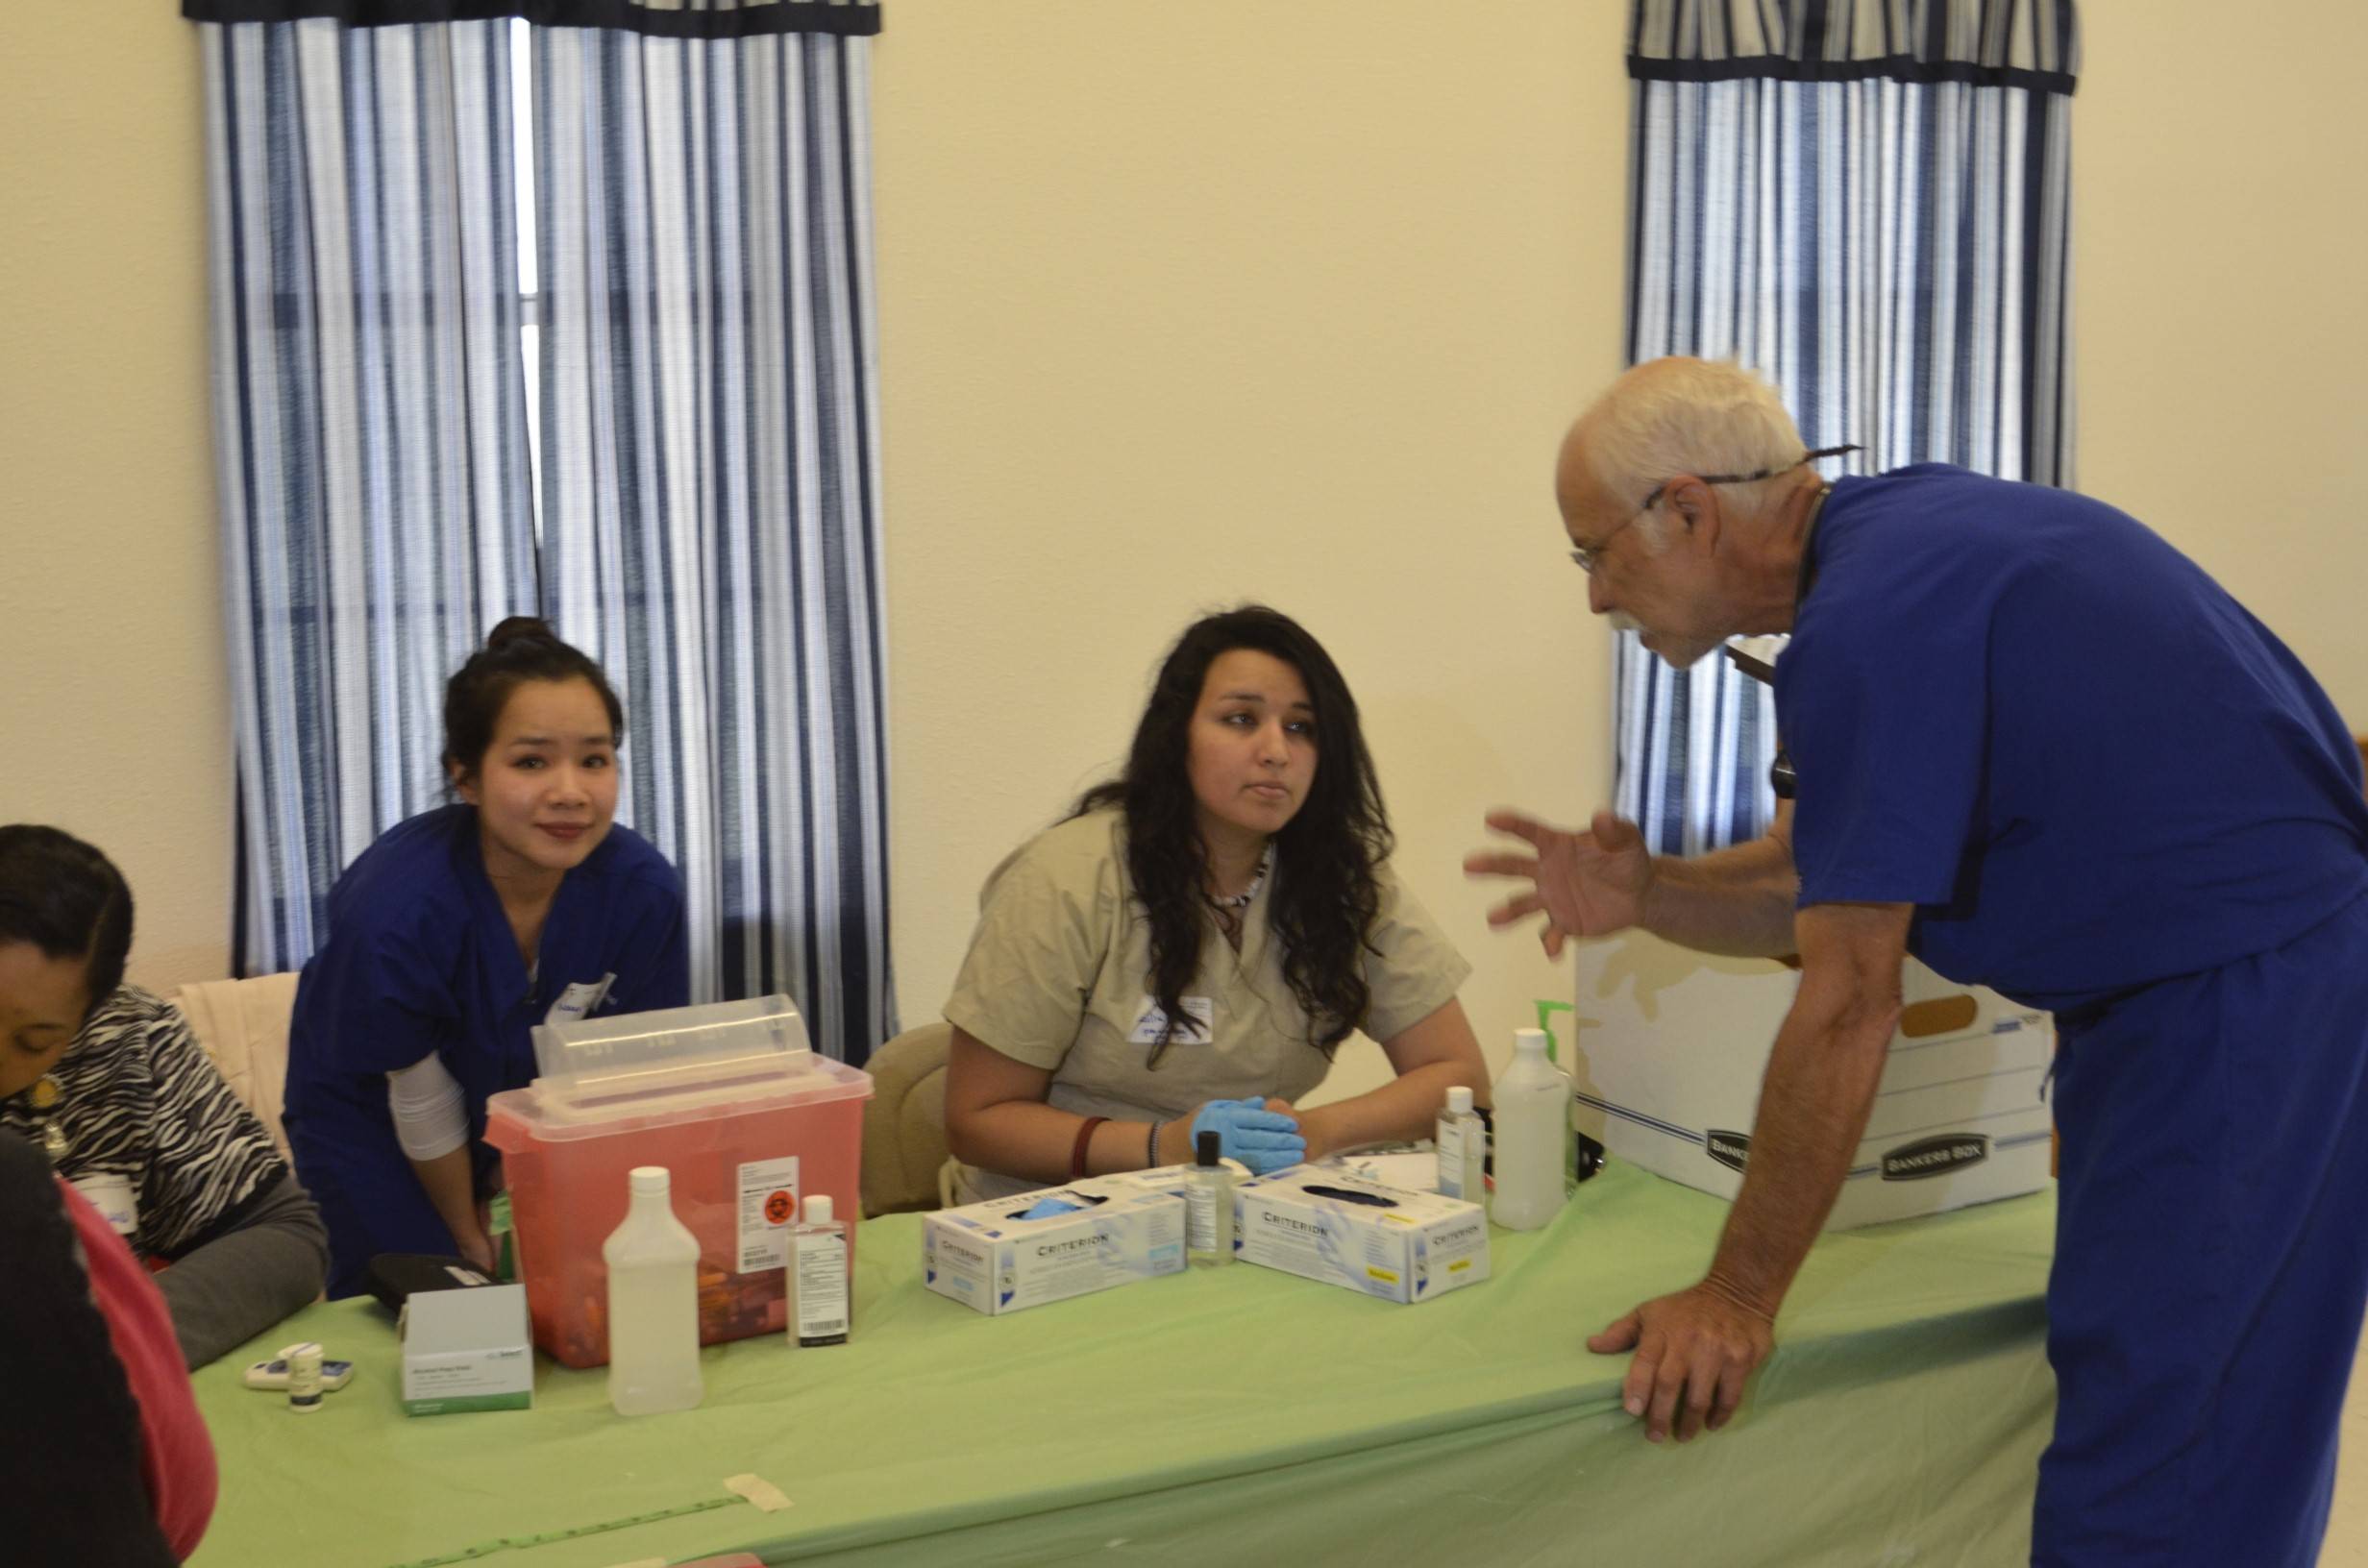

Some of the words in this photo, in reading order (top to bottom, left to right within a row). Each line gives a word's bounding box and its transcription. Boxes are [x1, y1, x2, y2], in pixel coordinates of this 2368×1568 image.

[1713, 1138, 1749, 1163] BANKE
[1887, 1152, 1950, 1172] BANKERS
[1952, 1144, 1982, 1159] BOX
[1262, 1212, 1329, 1237] CRITERION
[1432, 1225, 1480, 1246] CRITERION
[942, 1240, 984, 1263] CRITERION
[1037, 1234, 1110, 1257] CRITERION
